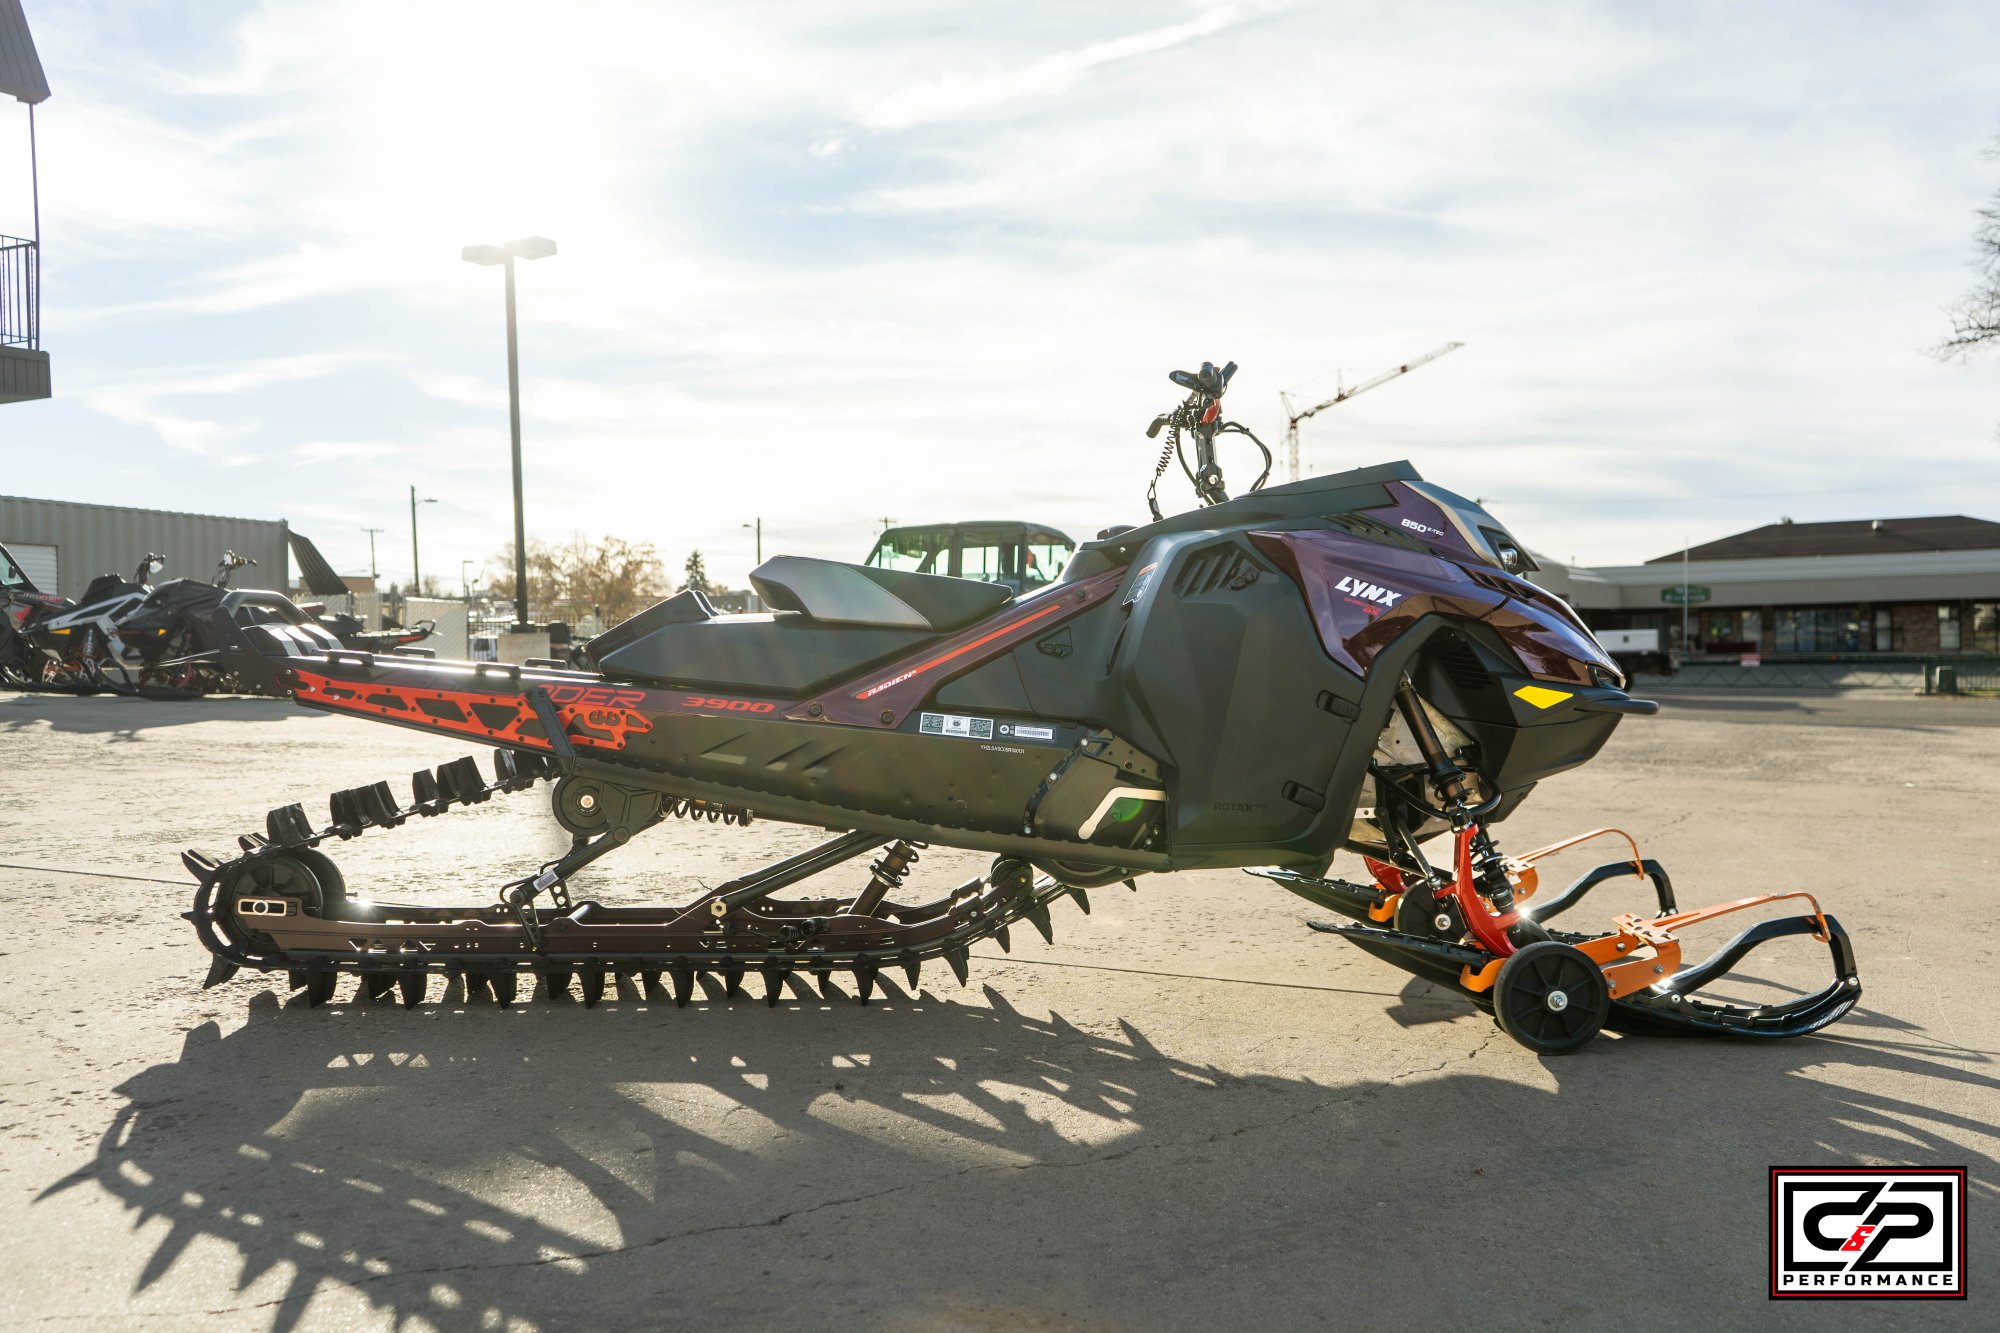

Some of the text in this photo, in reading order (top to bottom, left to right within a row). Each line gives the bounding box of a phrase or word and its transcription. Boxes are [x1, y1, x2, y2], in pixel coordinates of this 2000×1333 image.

[1401, 518, 1427, 533] 850
[1334, 576, 1402, 607] LYNX
[681, 696, 775, 713] 3900
